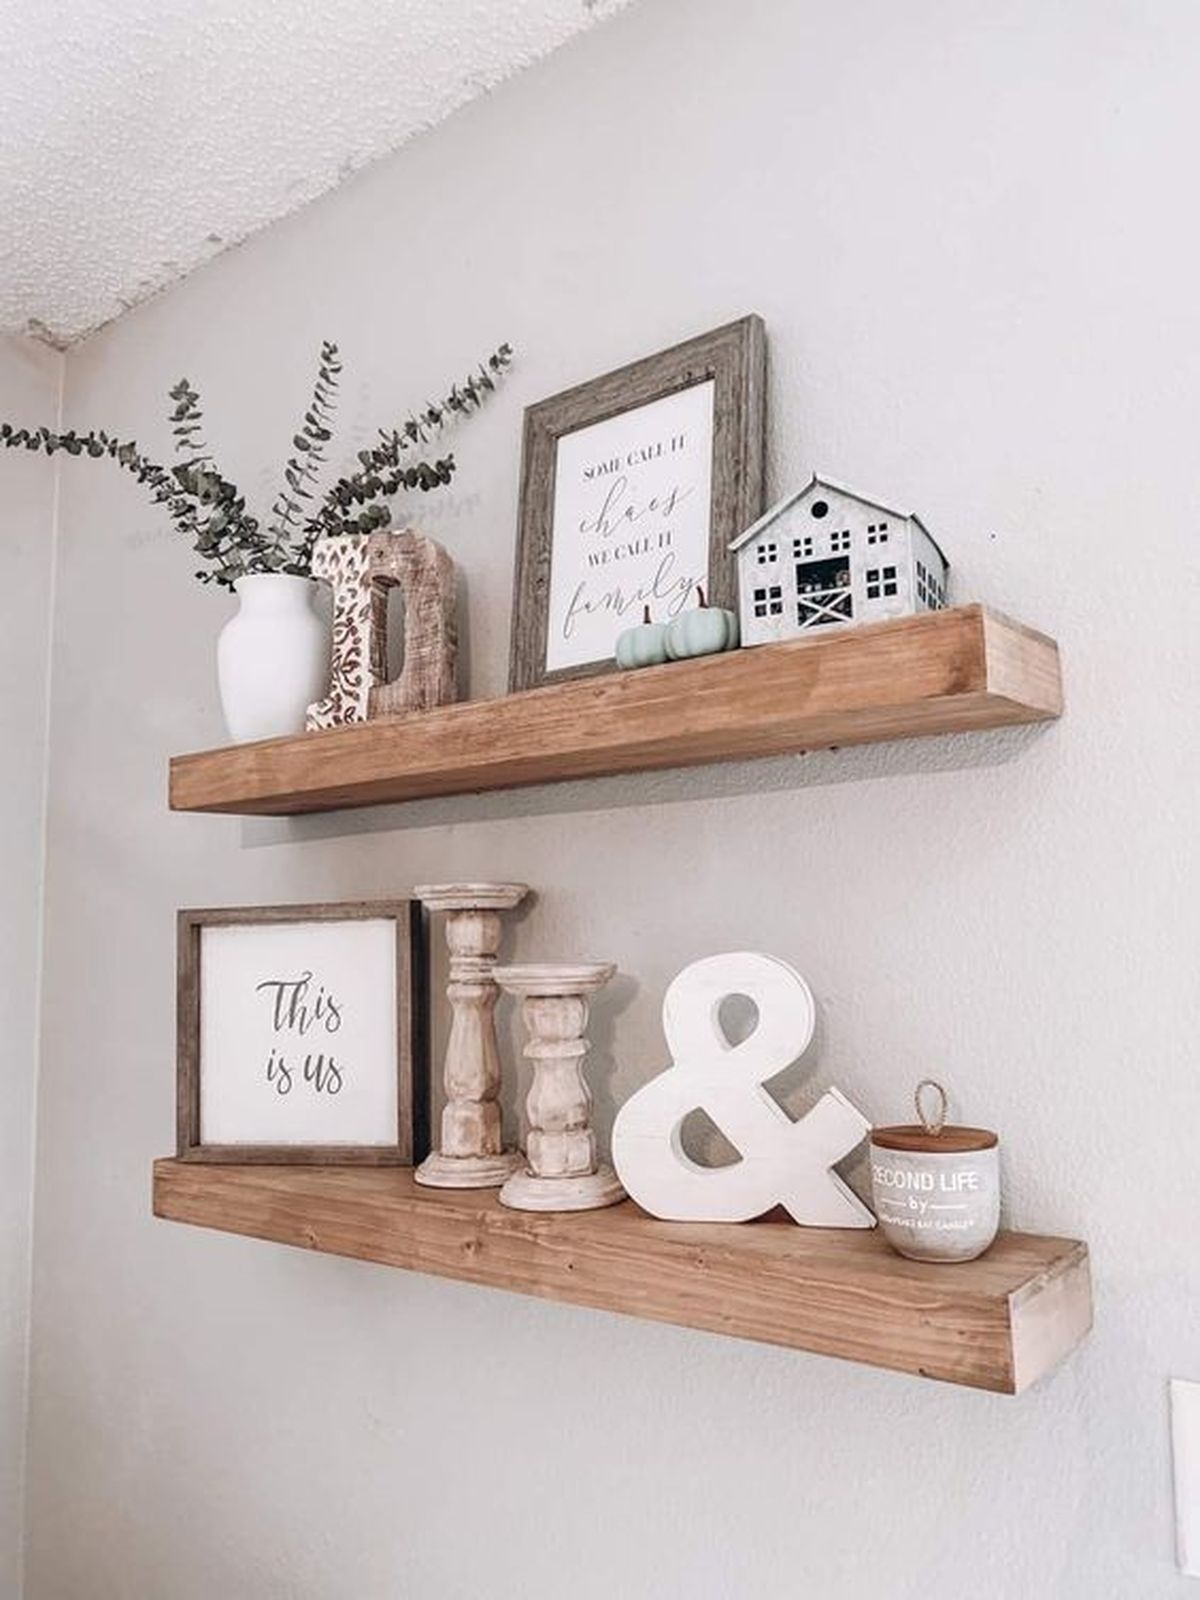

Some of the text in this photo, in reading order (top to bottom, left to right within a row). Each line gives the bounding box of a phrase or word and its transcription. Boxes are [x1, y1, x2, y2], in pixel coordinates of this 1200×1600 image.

[583, 434, 687, 482] SOME CALL IT
[579, 475, 696, 537] chaos
[588, 530, 674, 567] WE CALL IT
[563, 551, 706, 639] family
[256, 970, 344, 1035] This
[267, 1048, 343, 1095] is us
[611, 951, 877, 1229] &
[908, 1195, 929, 1215] by
[940, 1171, 979, 1192] LIFE
